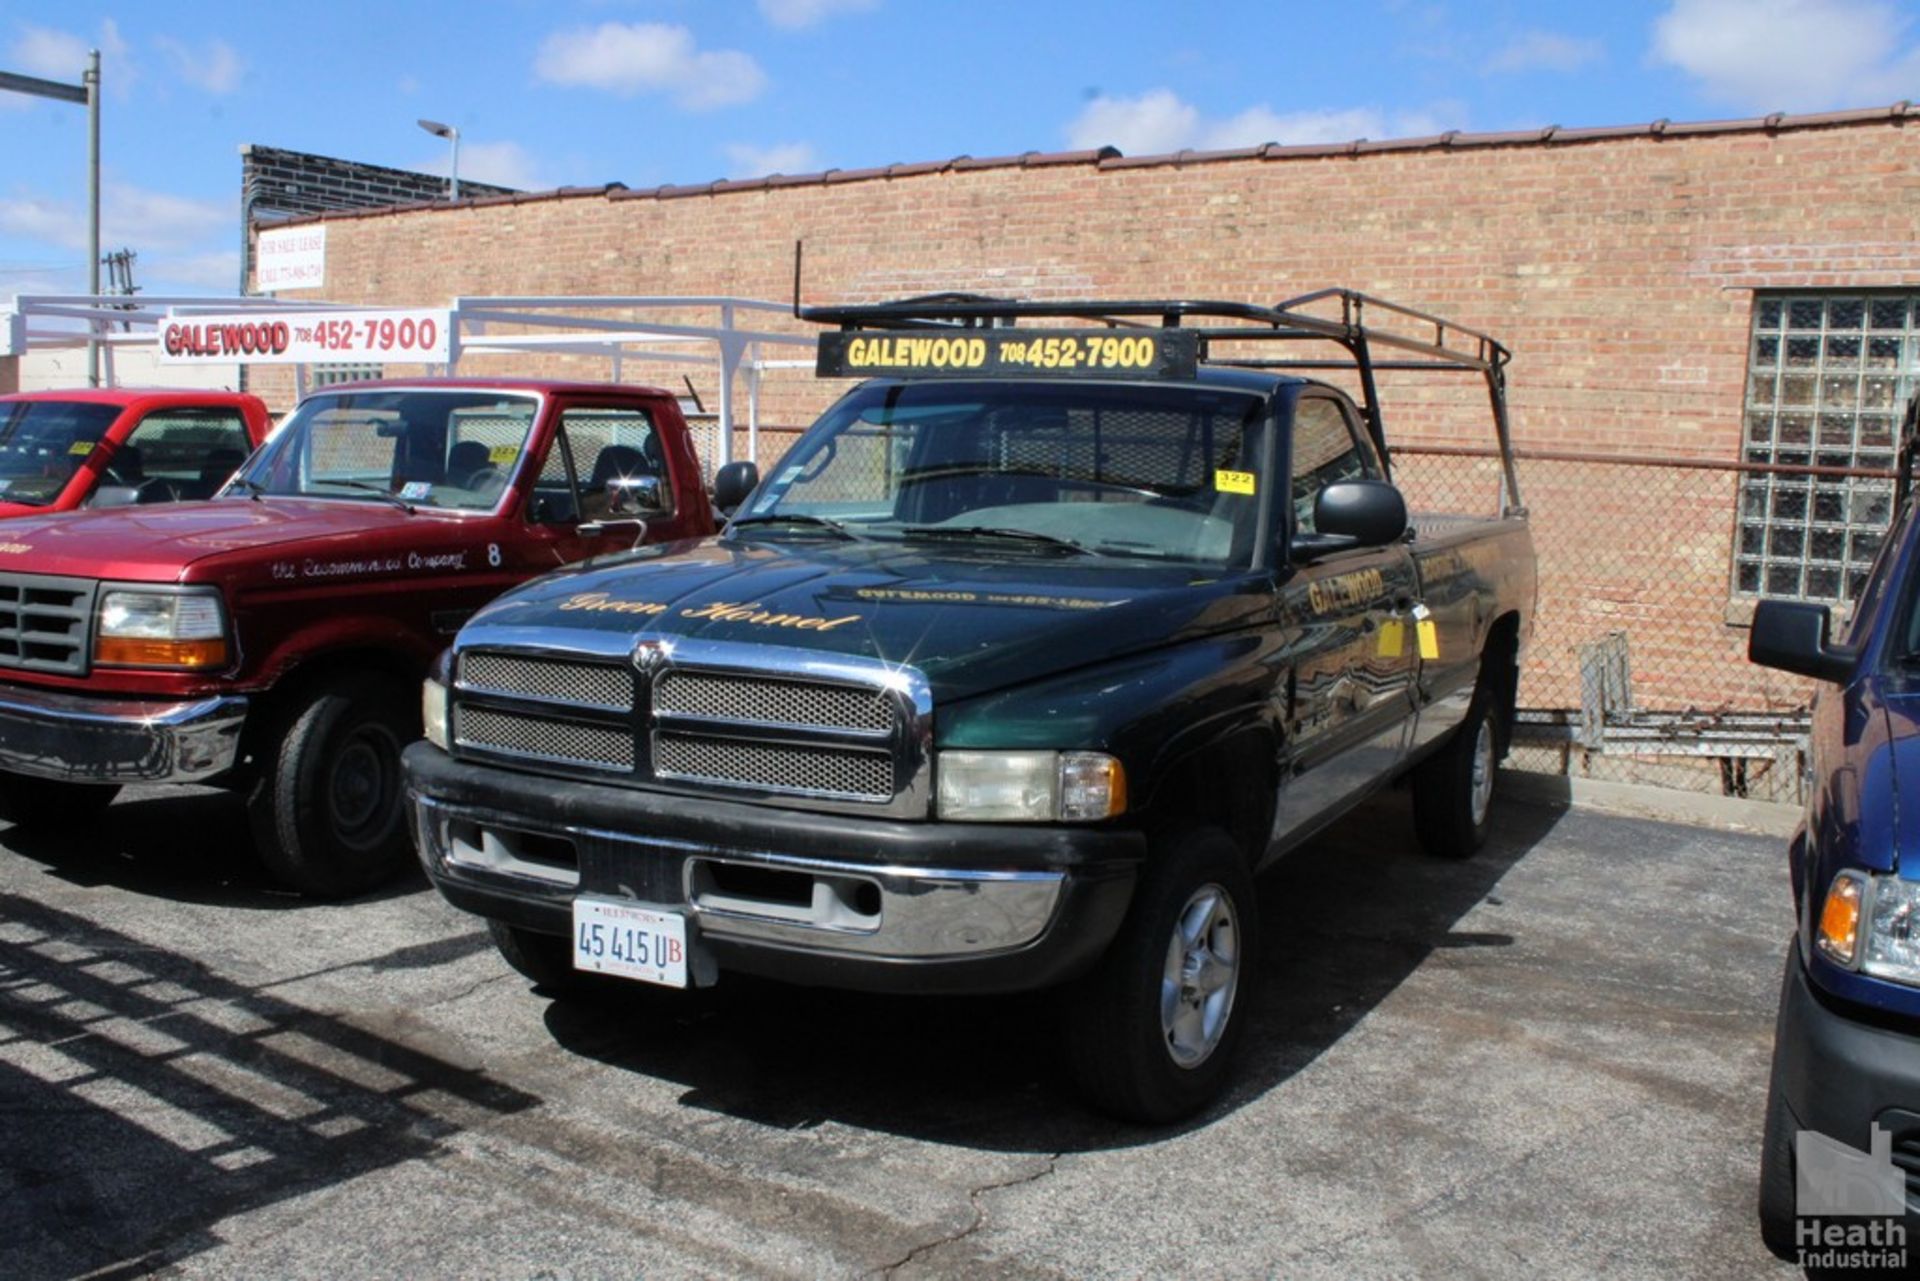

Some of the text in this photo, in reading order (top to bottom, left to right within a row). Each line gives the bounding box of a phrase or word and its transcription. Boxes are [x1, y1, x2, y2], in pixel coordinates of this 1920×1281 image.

[165, 318, 437, 356] GALEWOOD 708 452-7900
[848, 337, 1155, 368] GALEWOOD 708 452-7900
[487, 543, 501, 567] 8
[559, 591, 668, 614] Green
